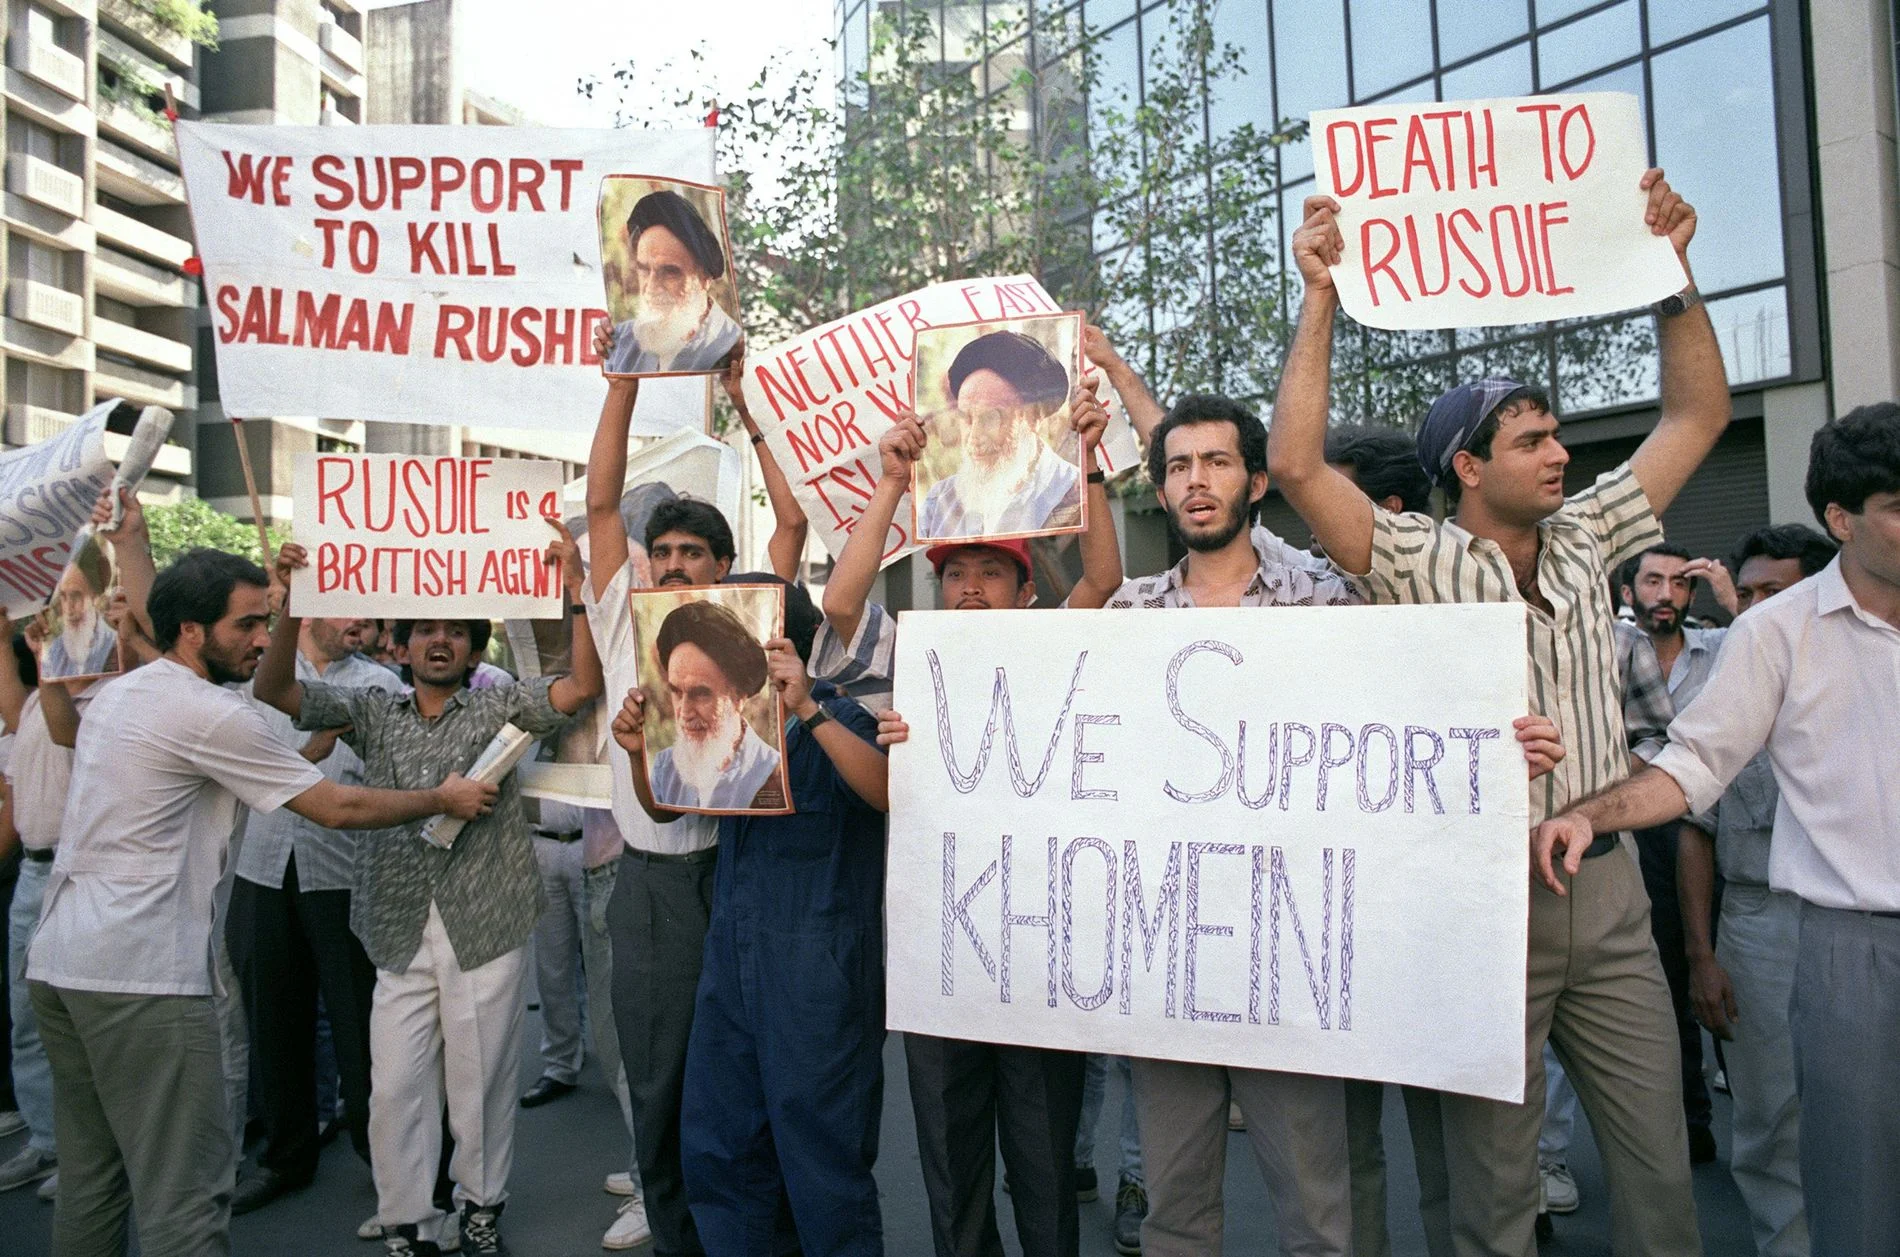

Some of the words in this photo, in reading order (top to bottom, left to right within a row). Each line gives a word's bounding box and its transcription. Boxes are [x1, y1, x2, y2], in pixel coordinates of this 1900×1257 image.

[221, 150, 293, 206] WE
[312, 154, 583, 213] SUPPORT
[1326, 108, 1498, 199] DEATH
[1517, 104, 1595, 183] TO
[314, 218, 379, 274] TO
[407, 222, 516, 275] KILL
[1361, 201, 1575, 306] RUSDIE
[217, 285, 414, 356] SALMAN
[434, 304, 609, 367] RUSHD
[754, 298, 932, 422] NEITHER
[961, 282, 1053, 322] EAST
[786, 401, 871, 473] NOR
[317, 457, 493, 538] RUSDIE
[317, 542, 467, 597] BRITISH
[941, 832, 1356, 1031] KHOMEINI
